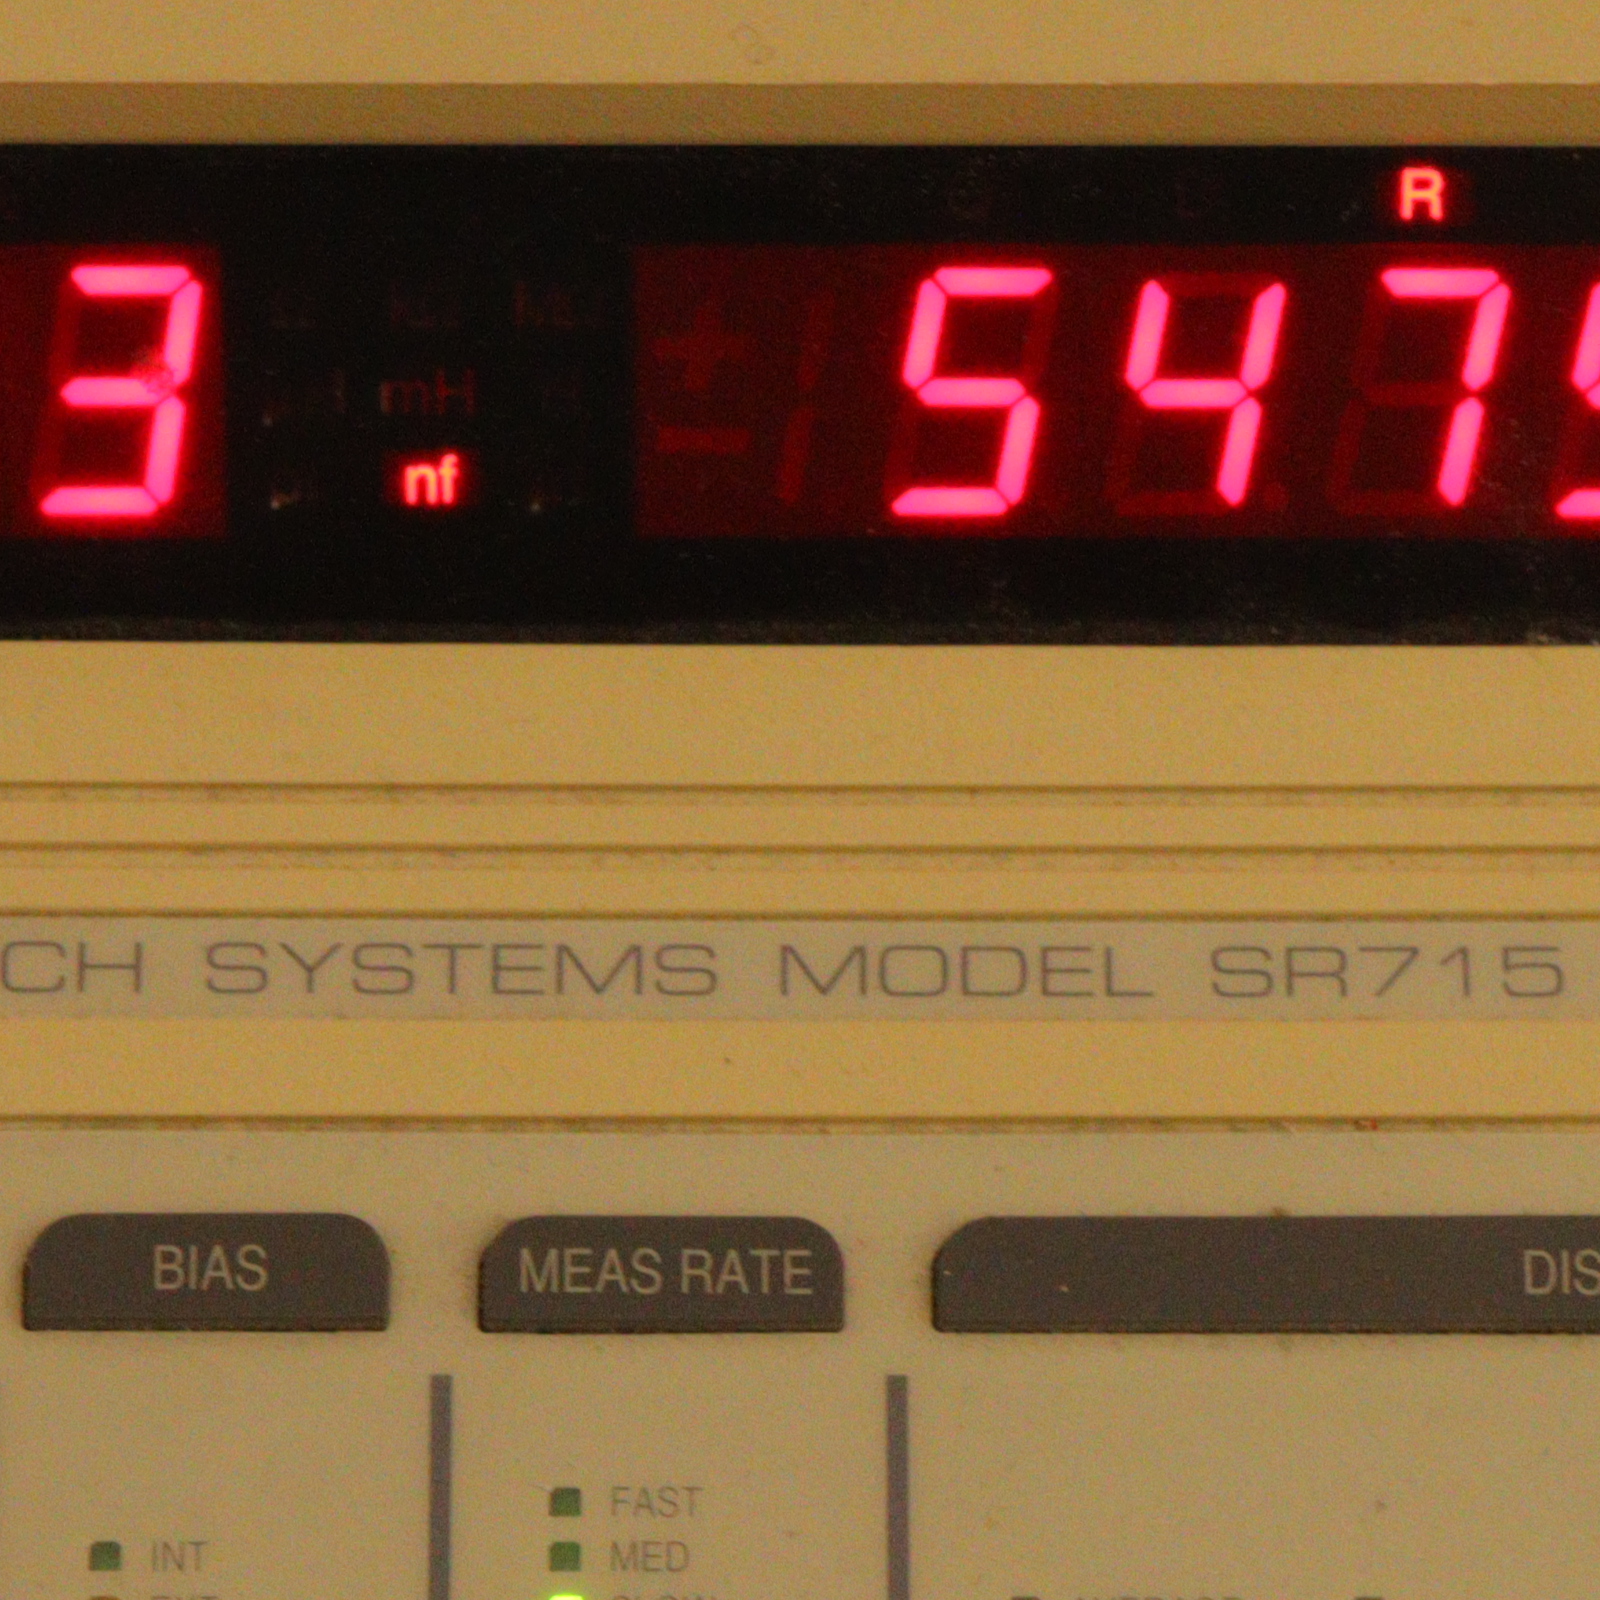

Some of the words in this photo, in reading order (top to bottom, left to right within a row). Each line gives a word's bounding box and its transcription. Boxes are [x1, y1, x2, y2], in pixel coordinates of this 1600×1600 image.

[1400, 168, 1445, 220] R
[404, 453, 458, 505] nf
[204, 940, 719, 998] SYSTEMS
[777, 943, 1155, 999] MODEL
[1209, 945, 1566, 1000] SR715
[153, 1243, 269, 1293] BIAS
[519, 1246, 663, 1296] MEAS
[680, 1247, 813, 1296] RATE
[609, 1484, 704, 1519] FAST
[150, 1539, 209, 1573] INT
[609, 1539, 691, 1574] MED
